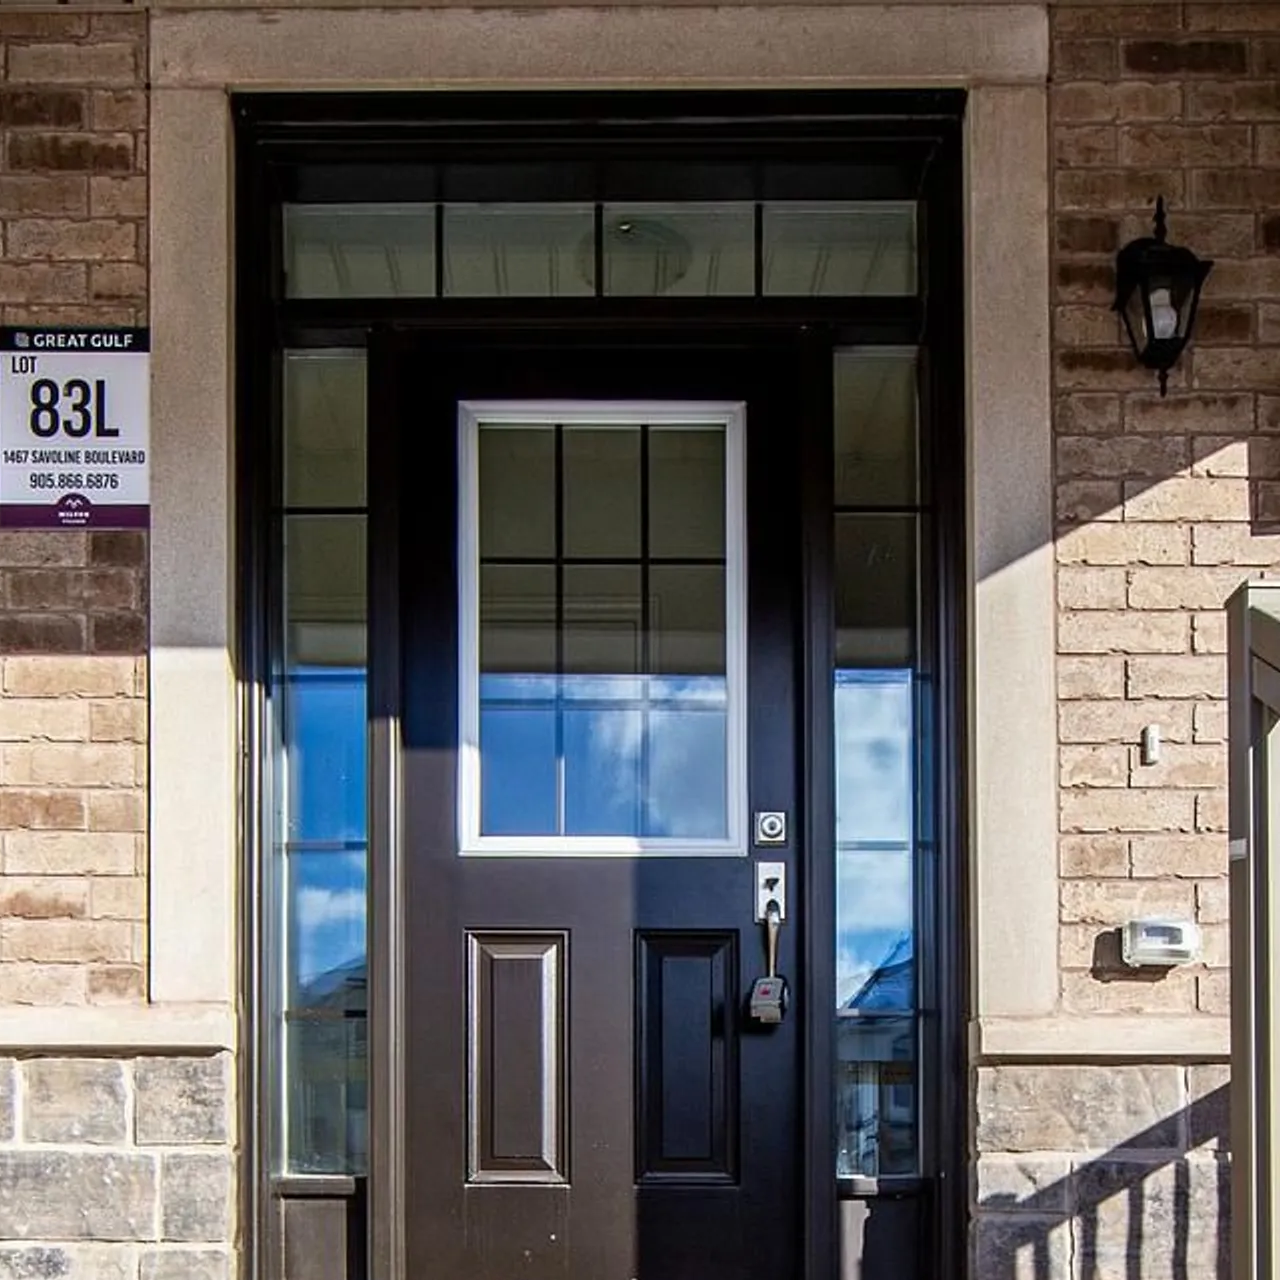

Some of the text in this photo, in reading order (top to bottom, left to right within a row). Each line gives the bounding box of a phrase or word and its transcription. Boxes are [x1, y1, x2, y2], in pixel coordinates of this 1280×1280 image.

[33, 334, 133, 348] GREAT GULF
[11, 356, 37, 374] LOT
[30, 378, 120, 438] 83L
[3, 450, 145, 464] 1467 SAVOLINE BOULEVARD
